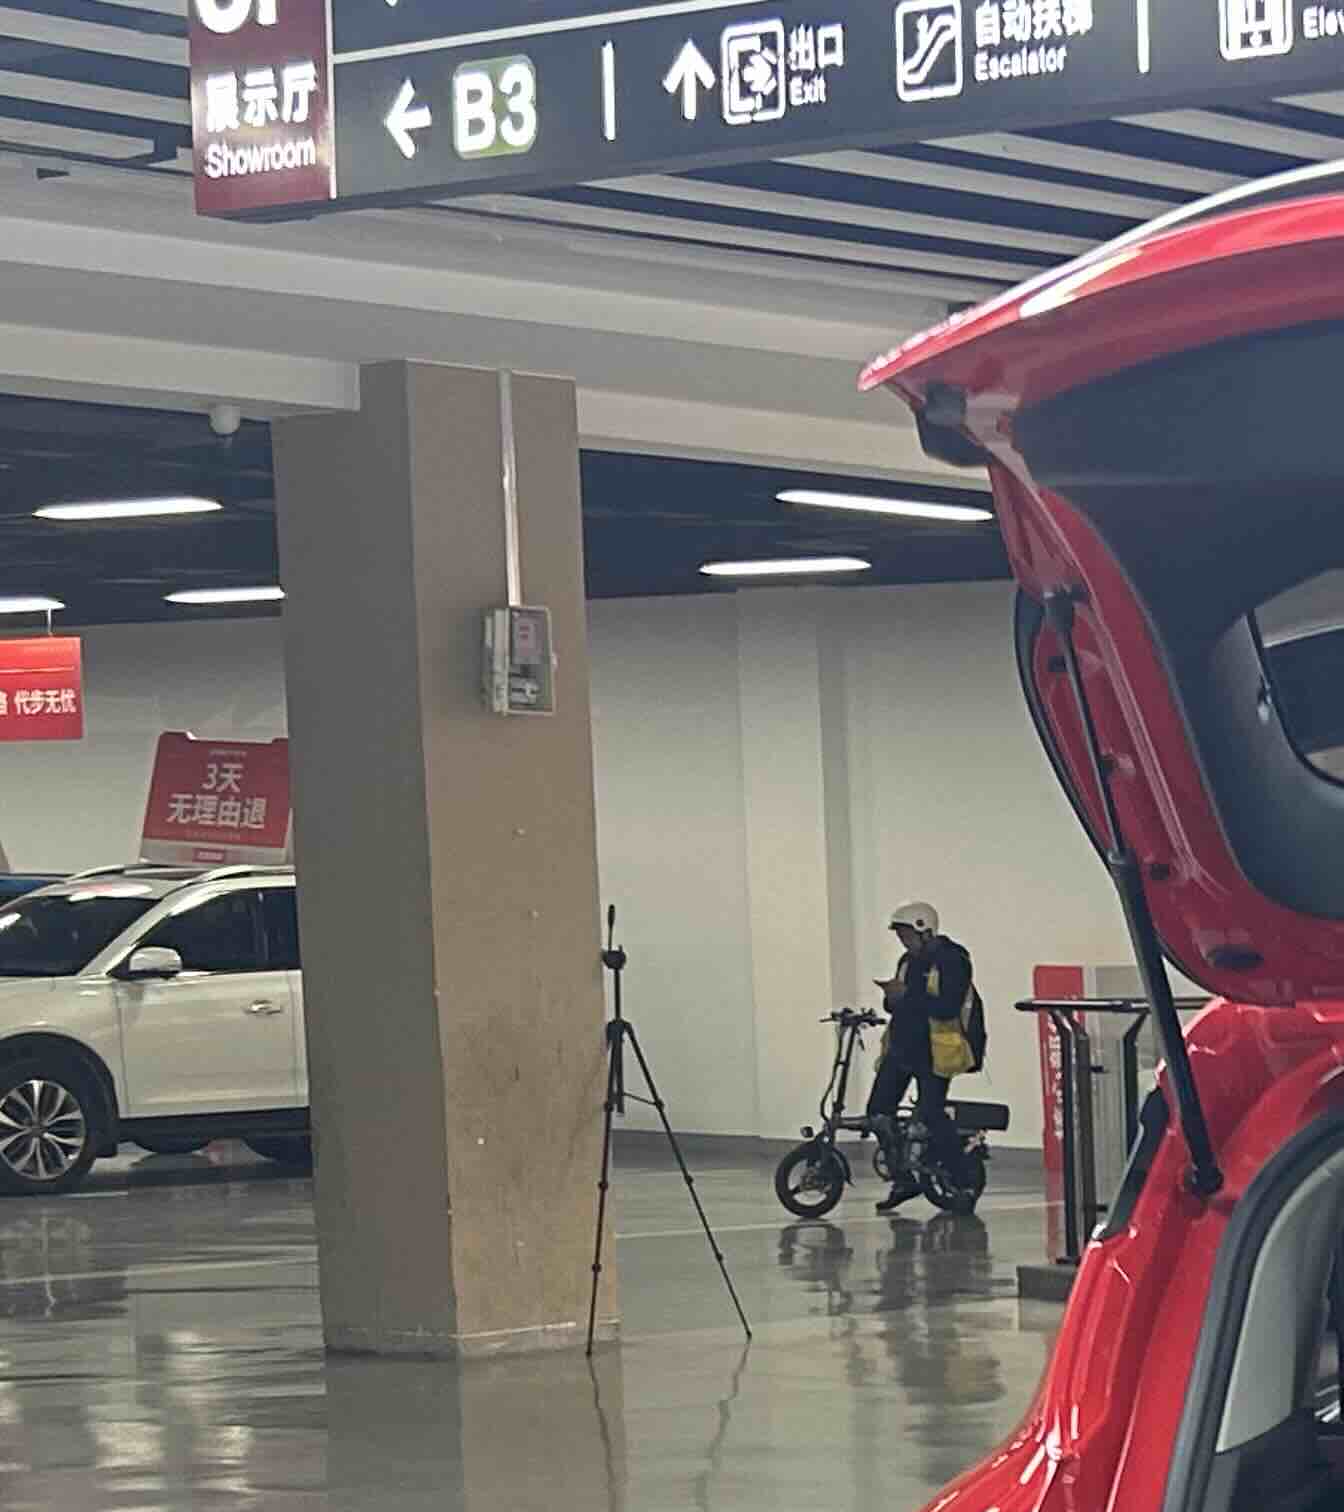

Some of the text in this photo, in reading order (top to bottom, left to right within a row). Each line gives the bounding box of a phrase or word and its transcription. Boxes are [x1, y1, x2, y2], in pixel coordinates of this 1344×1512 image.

[790, 23, 843, 71] 出口
[975, 45, 1067, 81] Escalator
[206, 60, 318, 133] 展示厅
[454, 62, 537, 153] B3
[790, 72, 826, 106] Exit
[205, 136, 316, 178] Showroom
[201, 762, 243, 793] 3天
[165, 793, 267, 830] 无理由退
